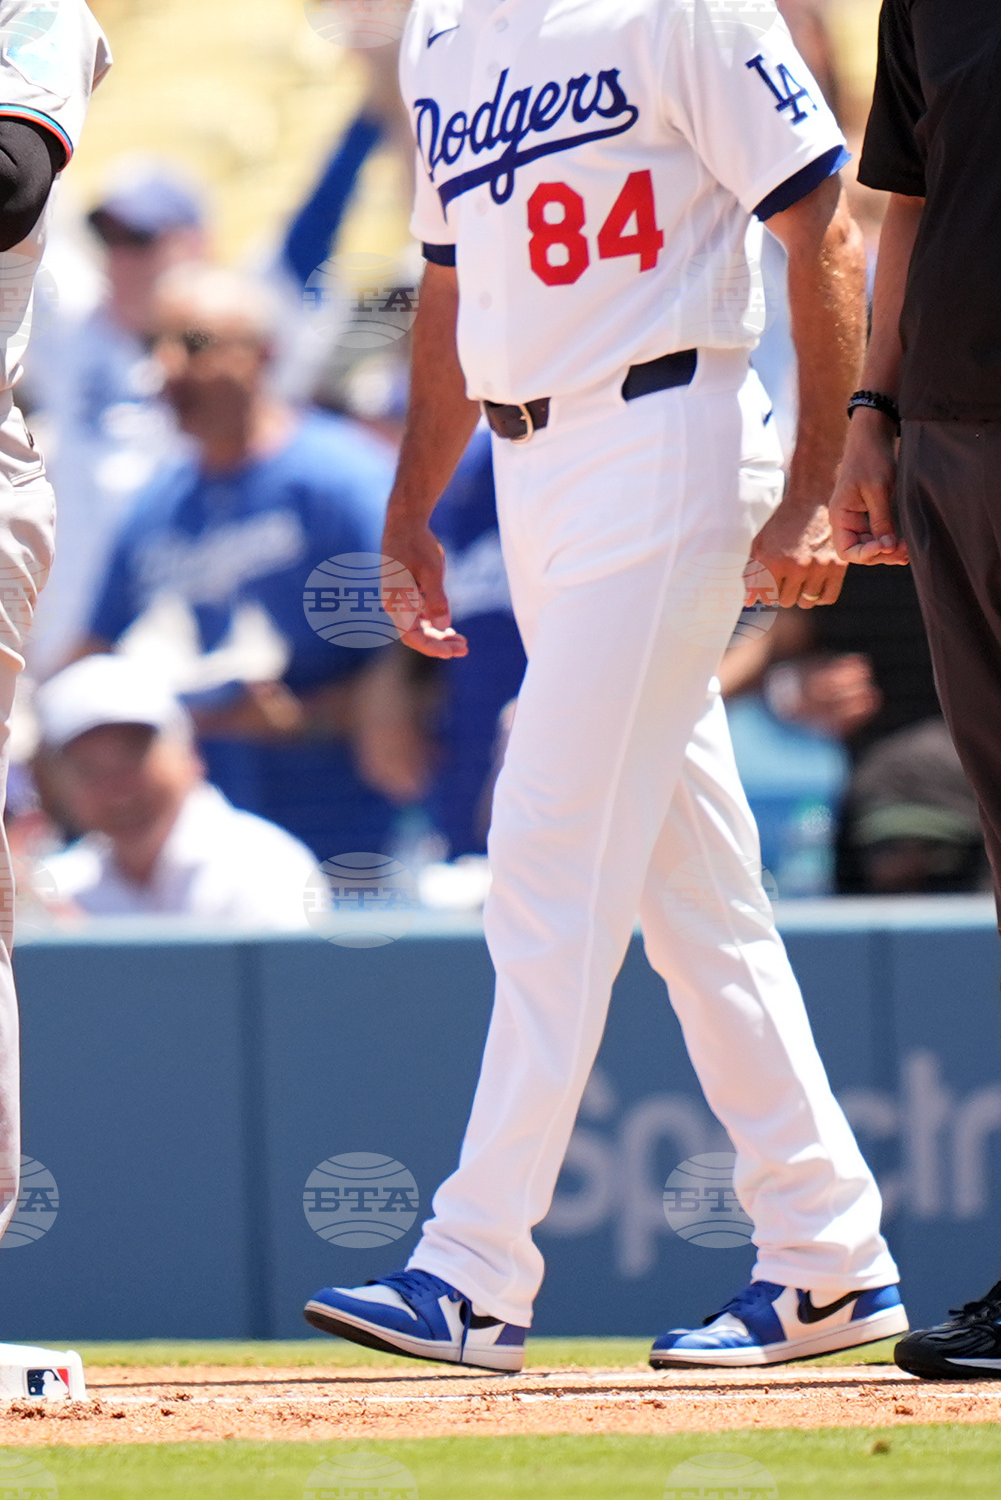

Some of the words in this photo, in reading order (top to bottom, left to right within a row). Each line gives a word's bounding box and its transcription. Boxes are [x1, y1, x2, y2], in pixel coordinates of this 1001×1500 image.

[413, 67, 639, 206] Dodgers
[744, 53, 818, 127] LA
[527, 169, 665, 287] 84
